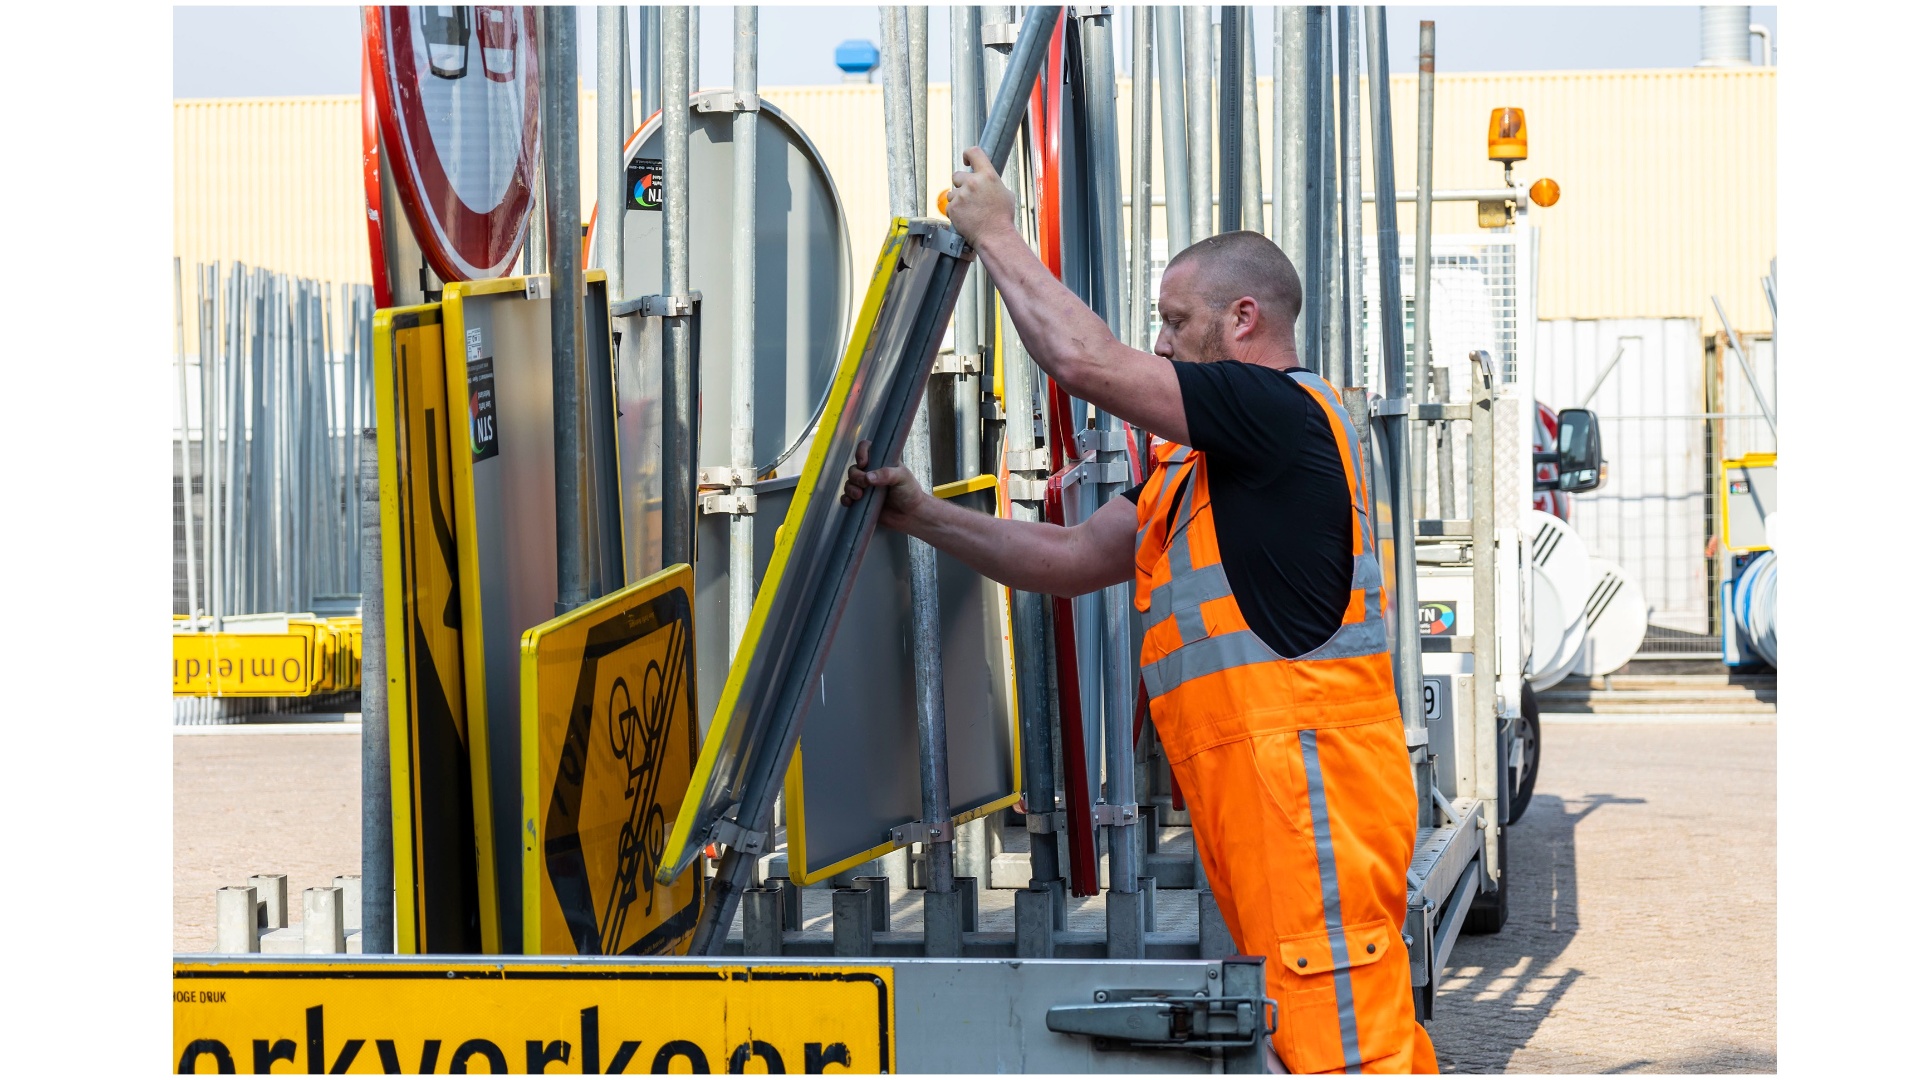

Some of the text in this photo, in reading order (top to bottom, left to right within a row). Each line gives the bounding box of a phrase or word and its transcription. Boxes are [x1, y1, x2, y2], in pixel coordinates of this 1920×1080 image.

[648, 188, 662, 202] TN
[477, 414, 493, 443] STN
[1418, 608, 1435, 622] TN
[173, 658, 301, 685] Omleidi
